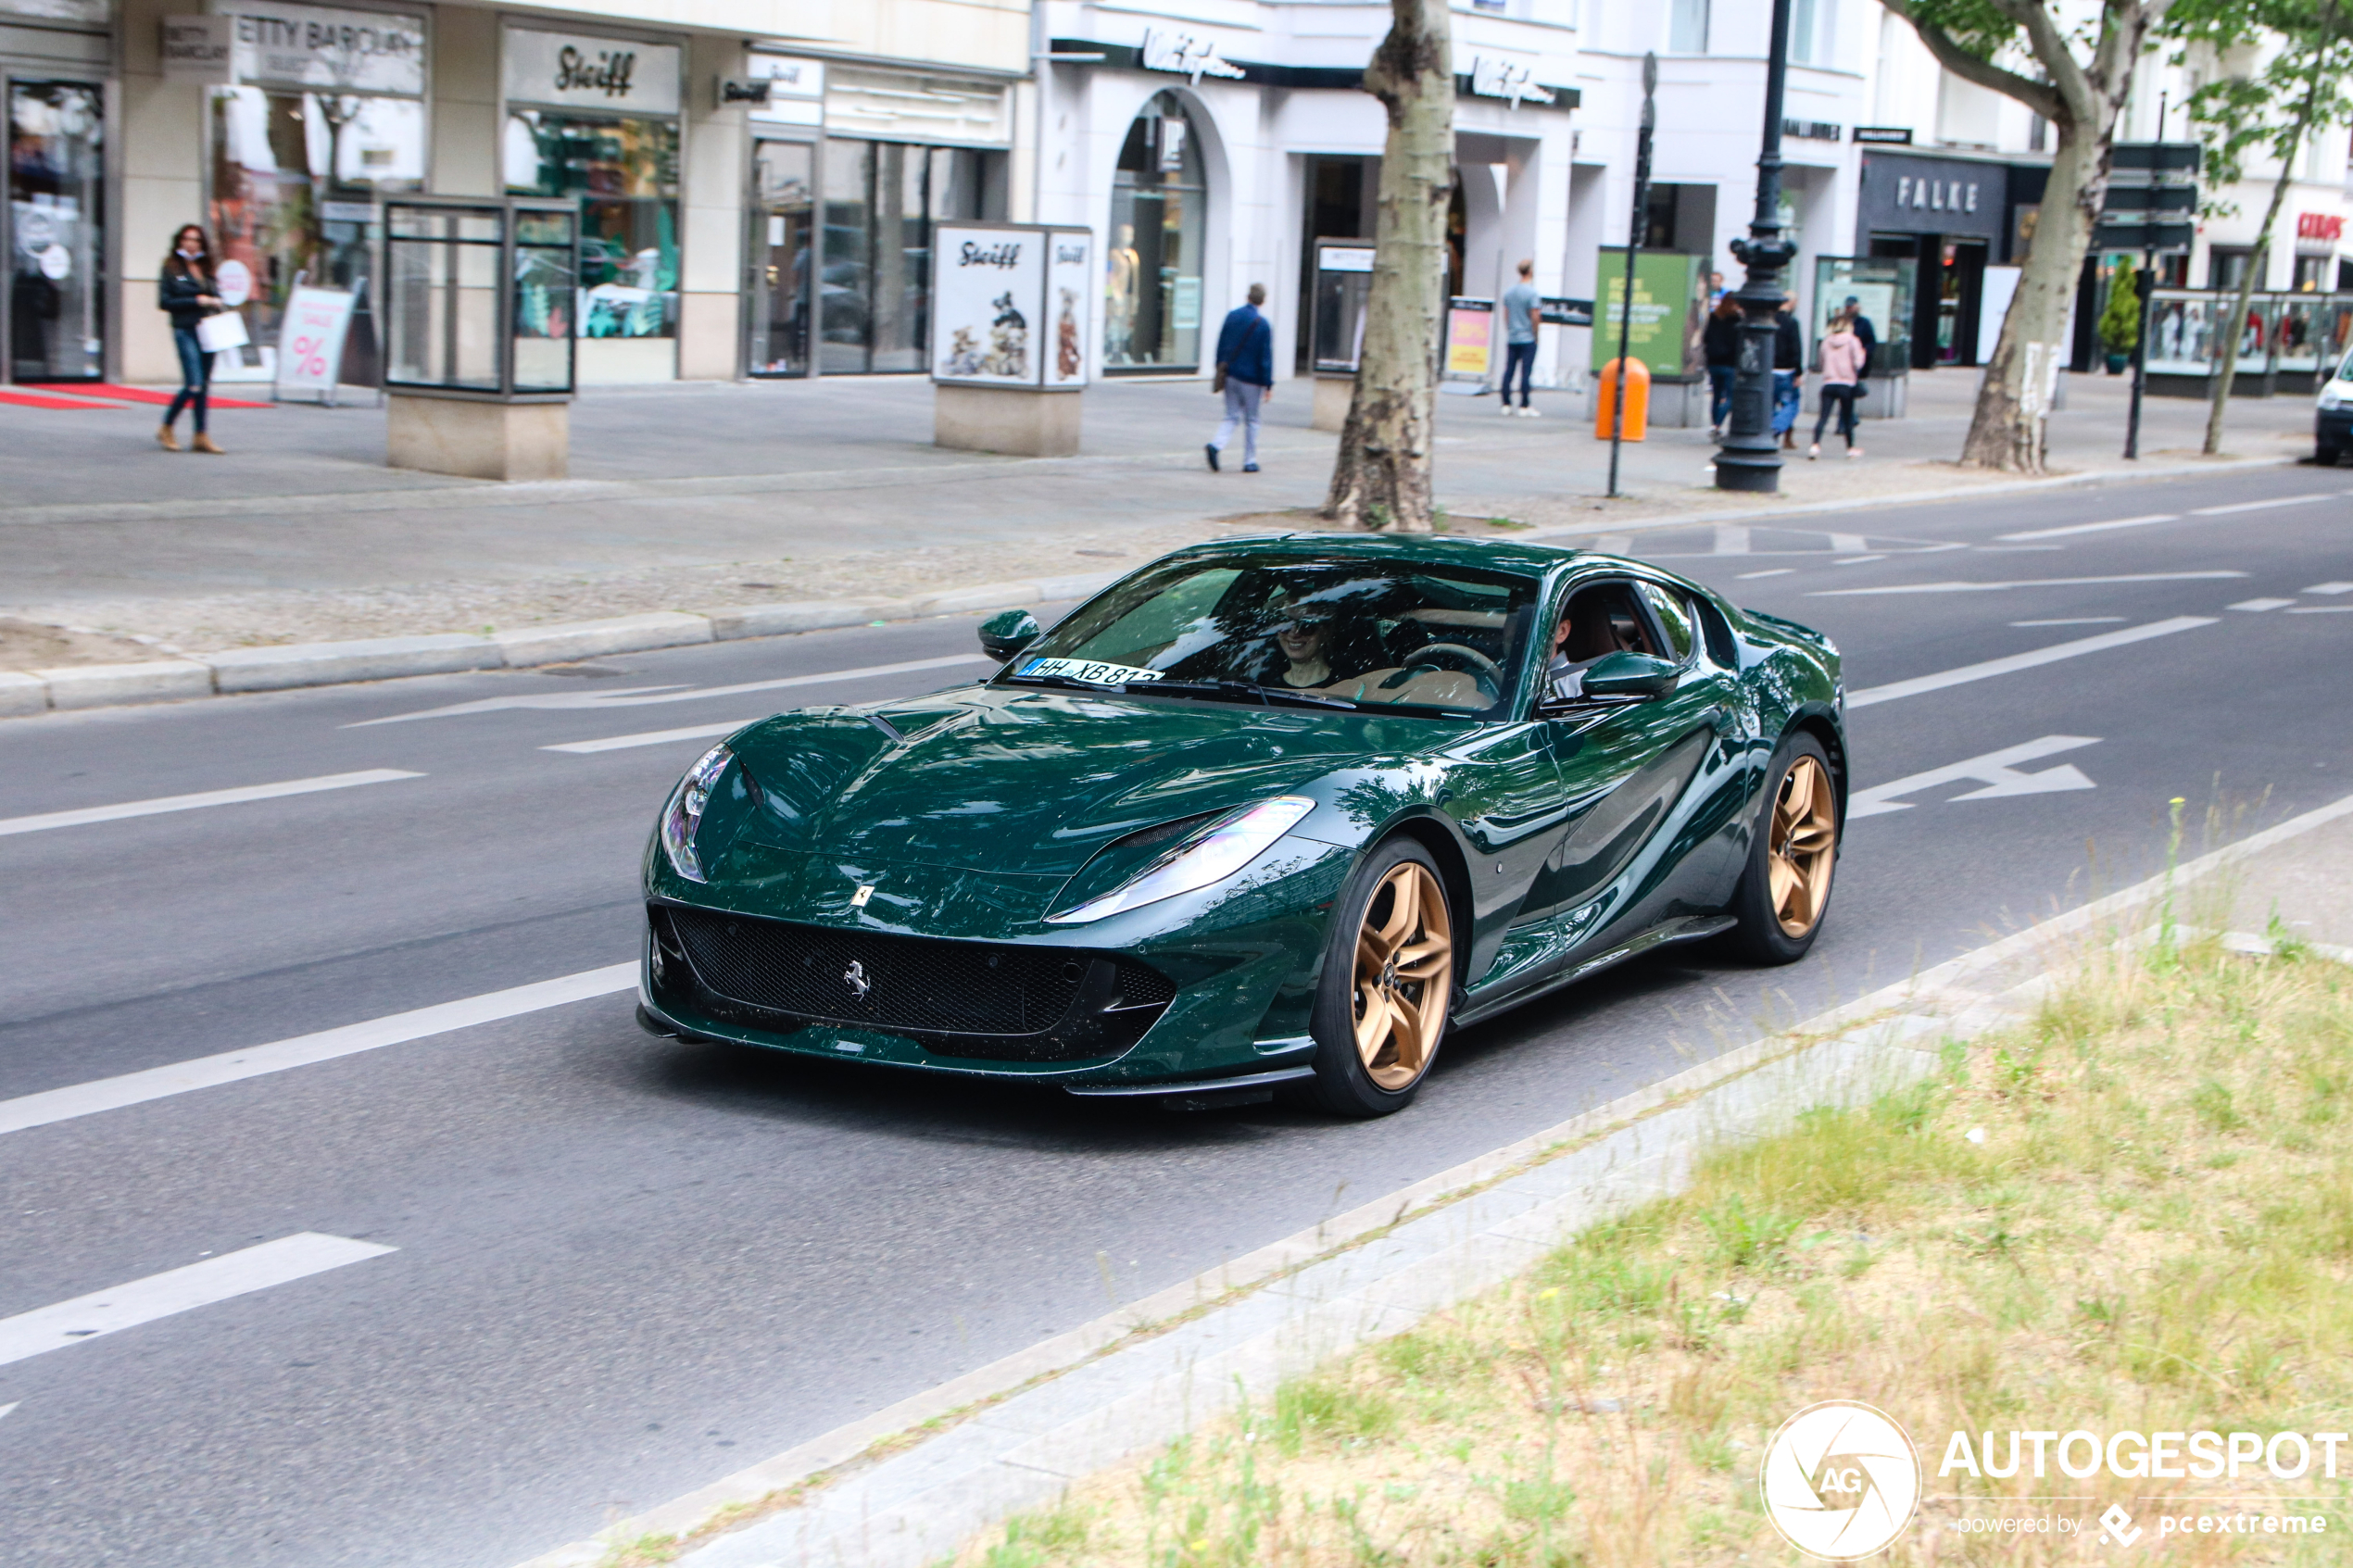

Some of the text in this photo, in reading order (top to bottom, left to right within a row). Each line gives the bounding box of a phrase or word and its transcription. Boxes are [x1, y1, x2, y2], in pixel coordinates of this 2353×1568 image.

[238, 14, 301, 46] ETTY
[556, 44, 636, 97] Steiff
[1896, 175, 1979, 214] FALKE
[958, 241, 1023, 270] Steiff
[1030, 659, 1071, 675] HH
[1071, 662, 1110, 681] XB
